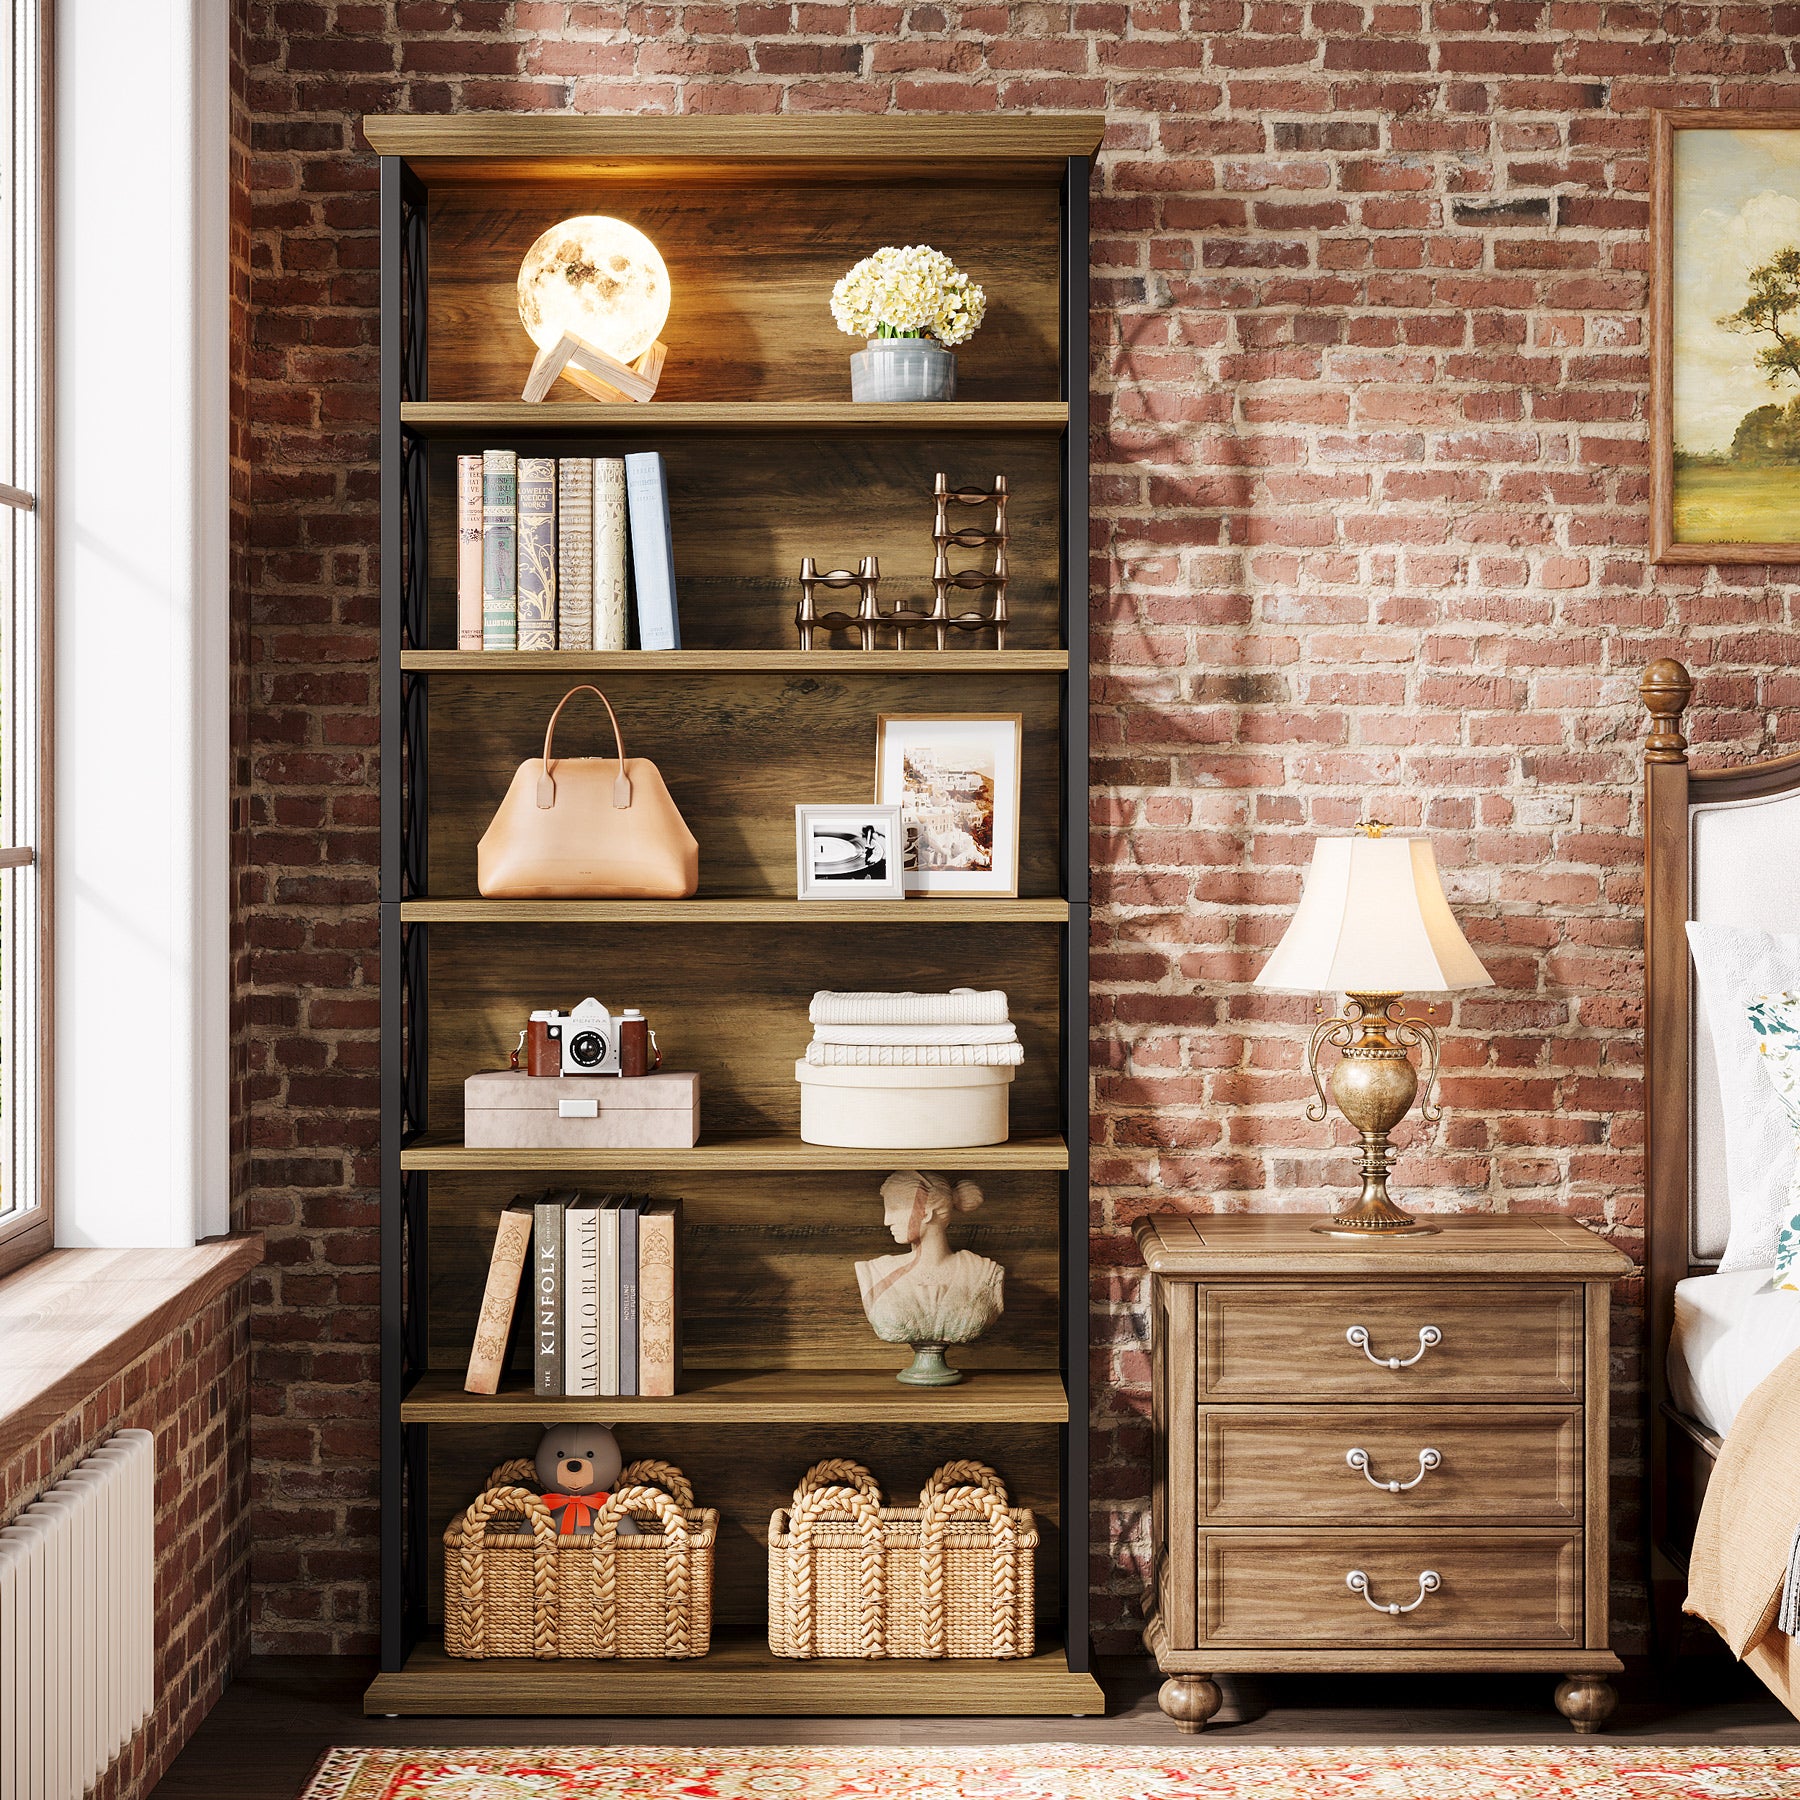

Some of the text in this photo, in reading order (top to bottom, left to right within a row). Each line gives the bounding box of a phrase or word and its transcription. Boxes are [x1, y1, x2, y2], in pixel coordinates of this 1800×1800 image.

[518, 487, 553, 495] LOWELL'S
[520, 494, 550, 502] POETICAL
[522, 501, 546, 509] WORKS
[484, 617, 517, 627] ILLUSTRATE
[541, 1245, 555, 1356] KINFOLK
[577, 1216, 598, 1390] MANOLO BLAHNÍK
